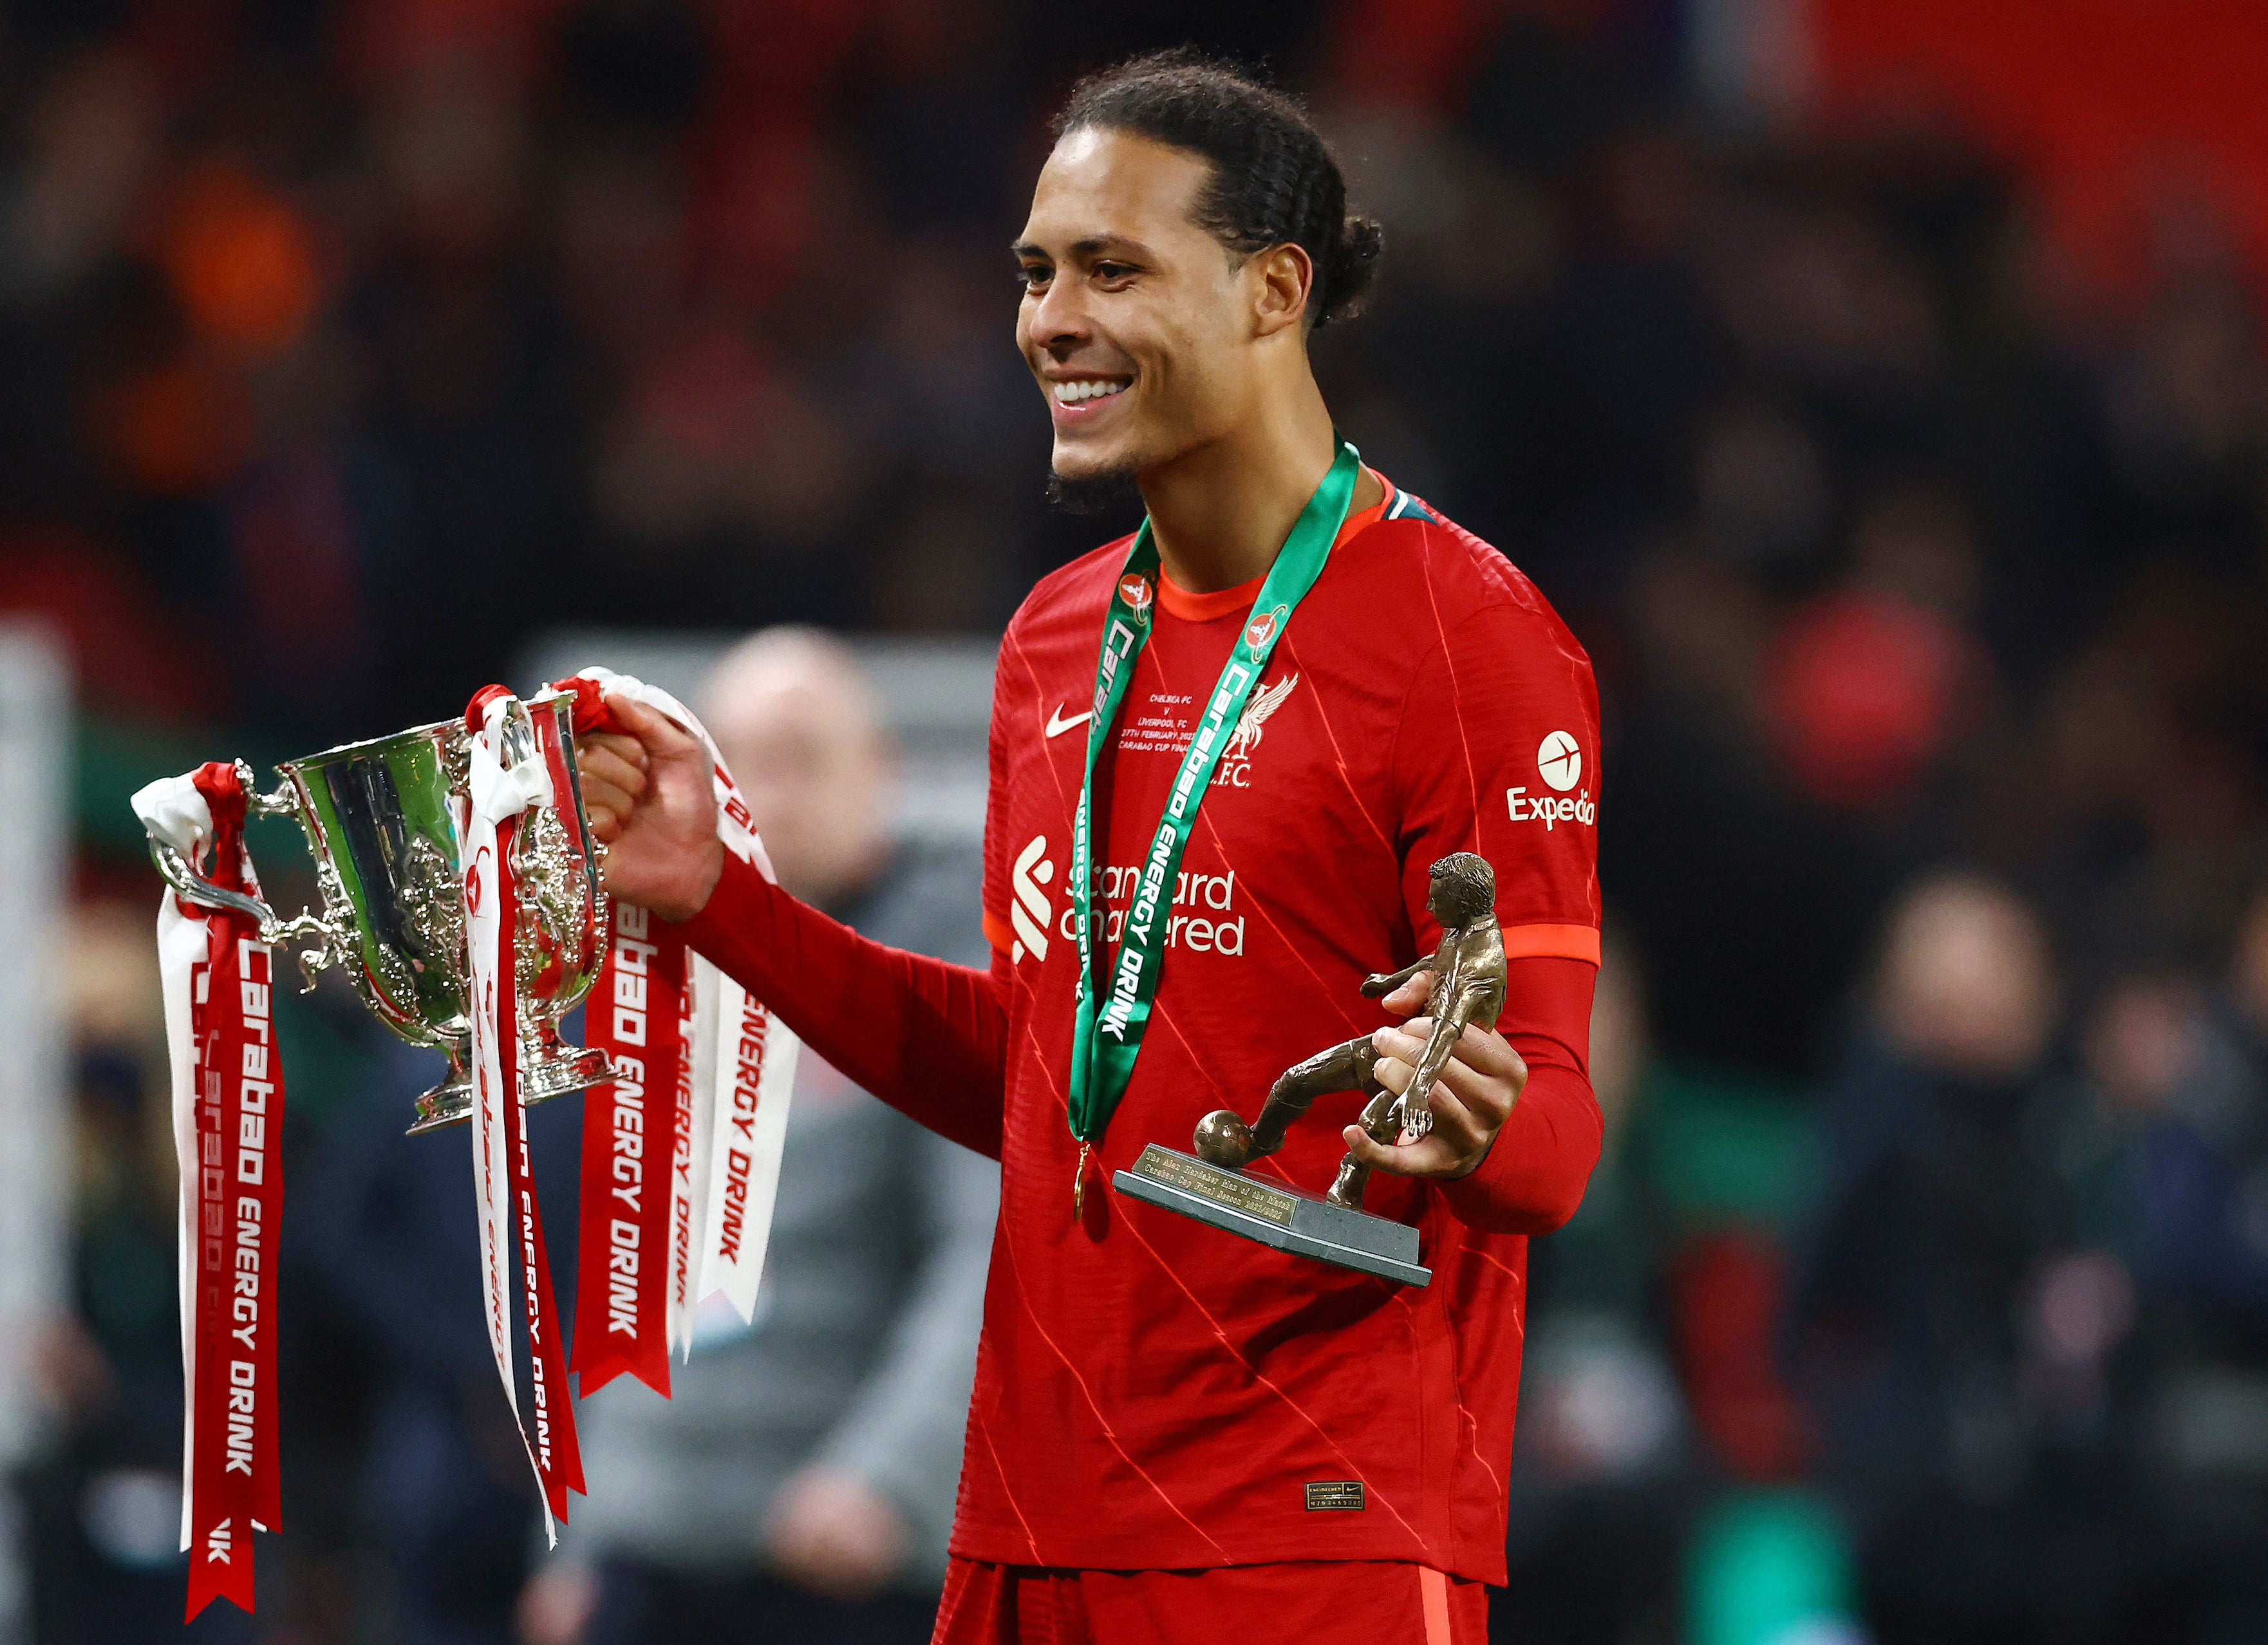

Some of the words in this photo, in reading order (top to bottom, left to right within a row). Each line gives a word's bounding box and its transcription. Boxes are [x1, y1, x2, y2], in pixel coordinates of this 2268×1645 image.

[1092, 619, 1135, 735] Carab
[1121, 729, 1139, 737] 27TH
[1141, 729, 1178, 739] FEBRUARY
[1138, 718, 1174, 728] LIVERPOOL
[1177, 720, 1188, 728] FC
[1150, 694, 1180, 704] CHELSEA
[1181, 695, 1192, 704] FC
[1118, 741, 1152, 751] CARABAO
[1155, 743, 1170, 751] CUP
[1168, 663, 1251, 819] Carabao
[1506, 786, 1595, 832] Expedia
[1130, 823, 1176, 946] ENERGY
[614, 901, 658, 1048] abao
[1101, 947, 1144, 1042] DRINK
[237, 938, 275, 1185] Carabao
[612, 1055, 644, 1213] ENERGY
[1144, 1163, 1175, 1181] Carabao
[1177, 1176, 1191, 1188] Cup
[1194, 1182, 1216, 1196] Final
[1217, 1190, 1242, 1206] Season
[1147, 1152, 1160, 1164] The
[1162, 1158, 1181, 1172] Alan
[1183, 1165, 1219, 1187] Hardaker
[1221, 1179, 1237, 1192] Man
[1241, 1186, 1250, 1195] of
[1252, 1190, 1264, 1201] the
[1267, 1196, 1291, 1210] Match
[677, 1195, 690, 1310] DRINK
[719, 1148, 752, 1265] DRINK
[232, 1196, 261, 1351] ENERGY
[608, 1219, 641, 1340] DRINK
[225, 1360, 256, 1477] DRINK
[532, 1355, 552, 1472] DRINK
